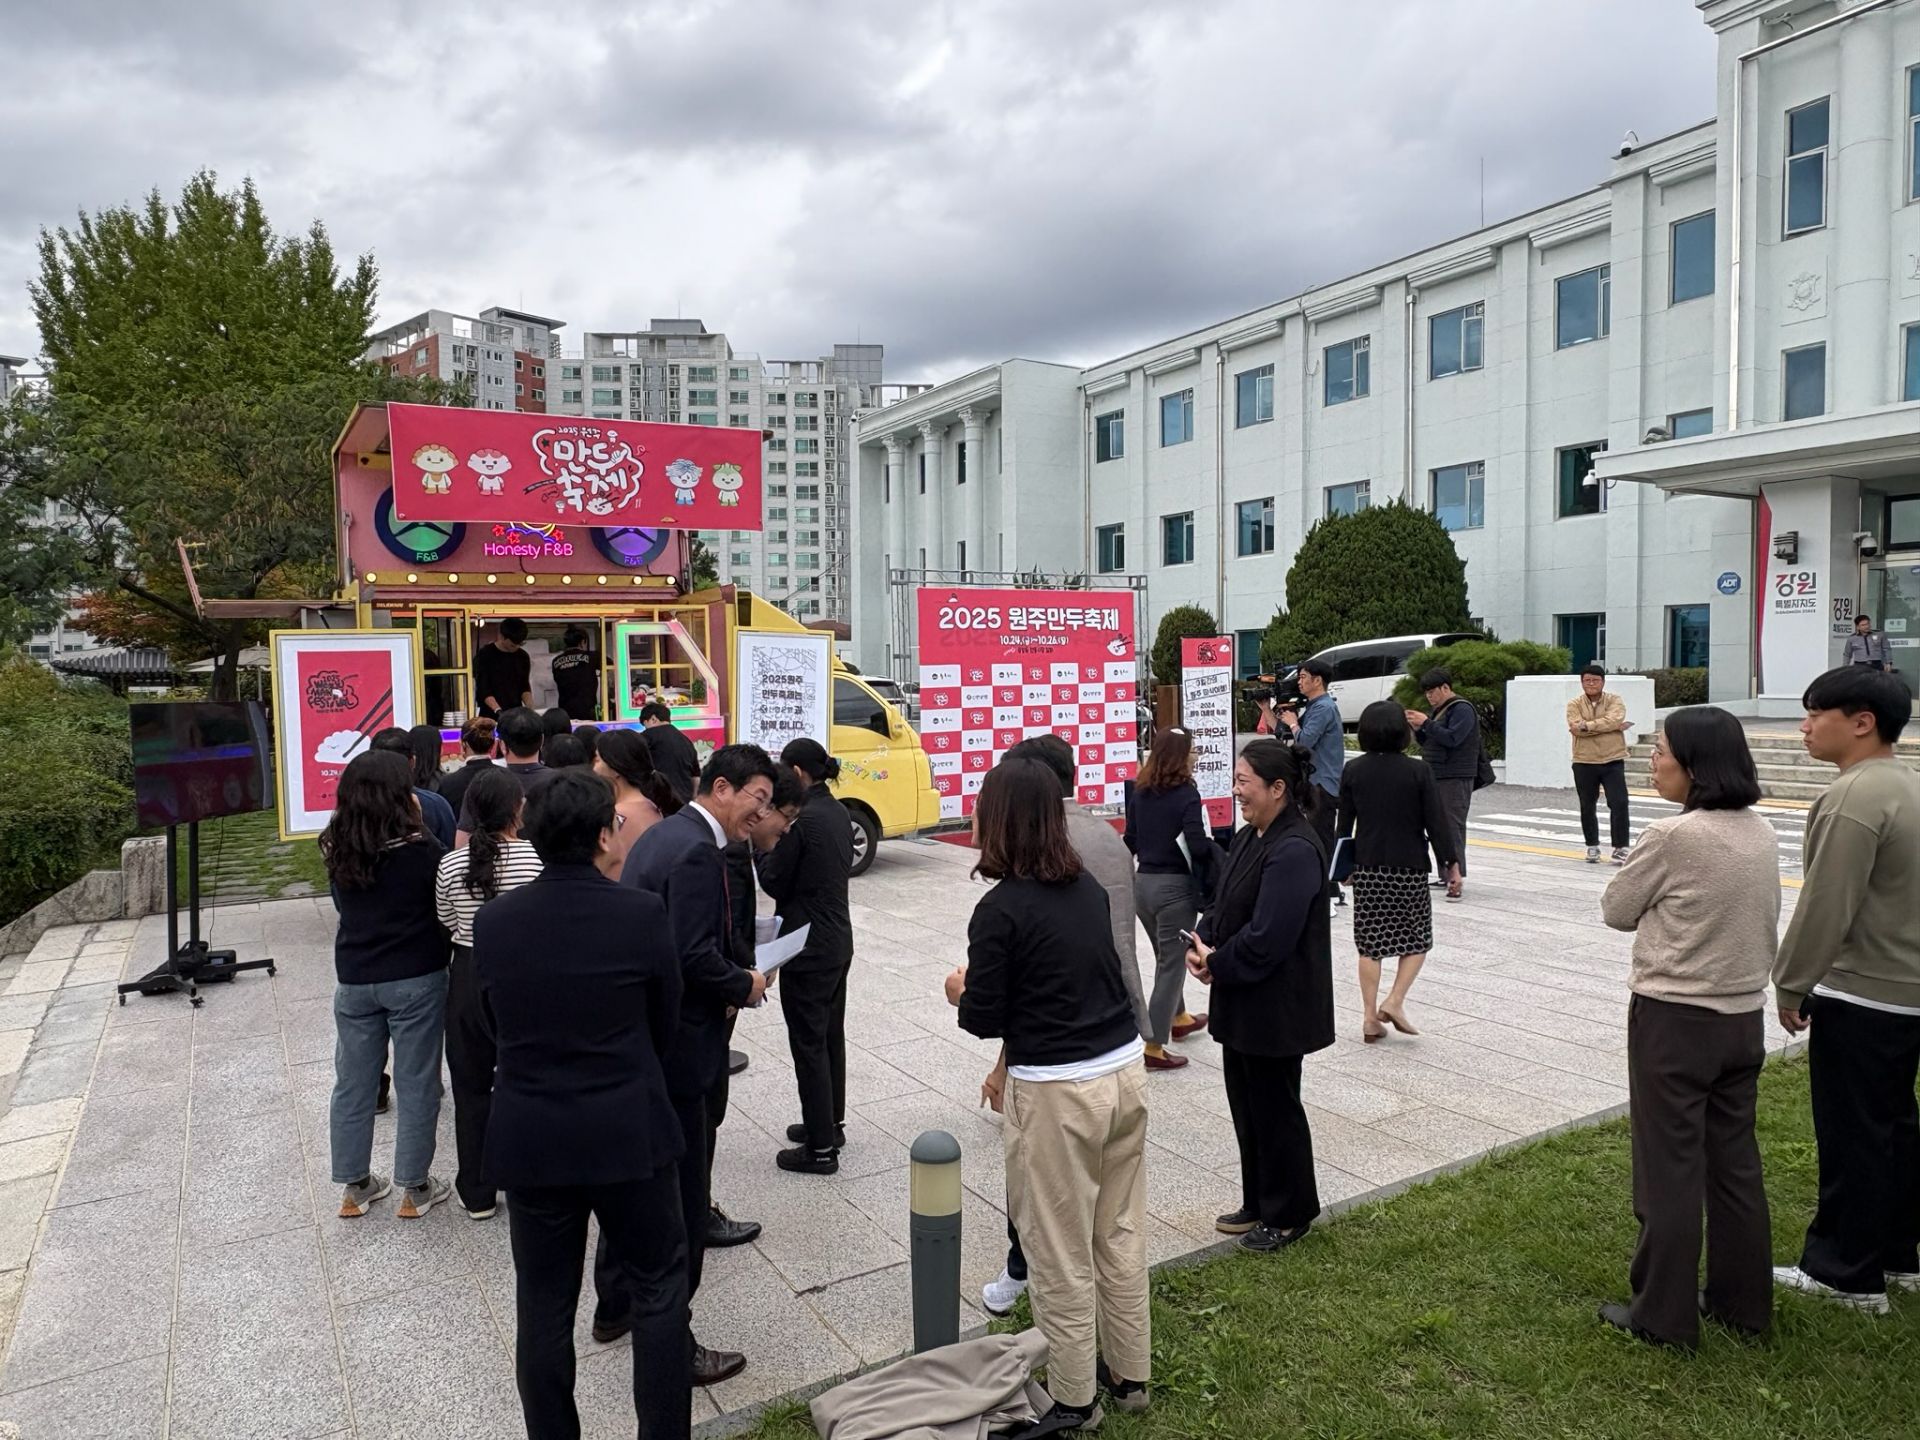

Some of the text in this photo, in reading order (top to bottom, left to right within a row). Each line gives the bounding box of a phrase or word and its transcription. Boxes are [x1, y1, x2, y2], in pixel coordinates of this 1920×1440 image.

[553, 439, 627, 475] 만두
[556, 467, 627, 512] 축제
[416, 552, 438, 561] F&B
[484, 543, 573, 559] Honesty F&B
[1720, 578, 1737, 588] ADT
[1776, 572, 1816, 597] 강원
[1775, 598, 1816, 609] 특별자치도
[1833, 598, 1853, 621] 강원
[939, 606, 1119, 631] 2025 원주만두축제
